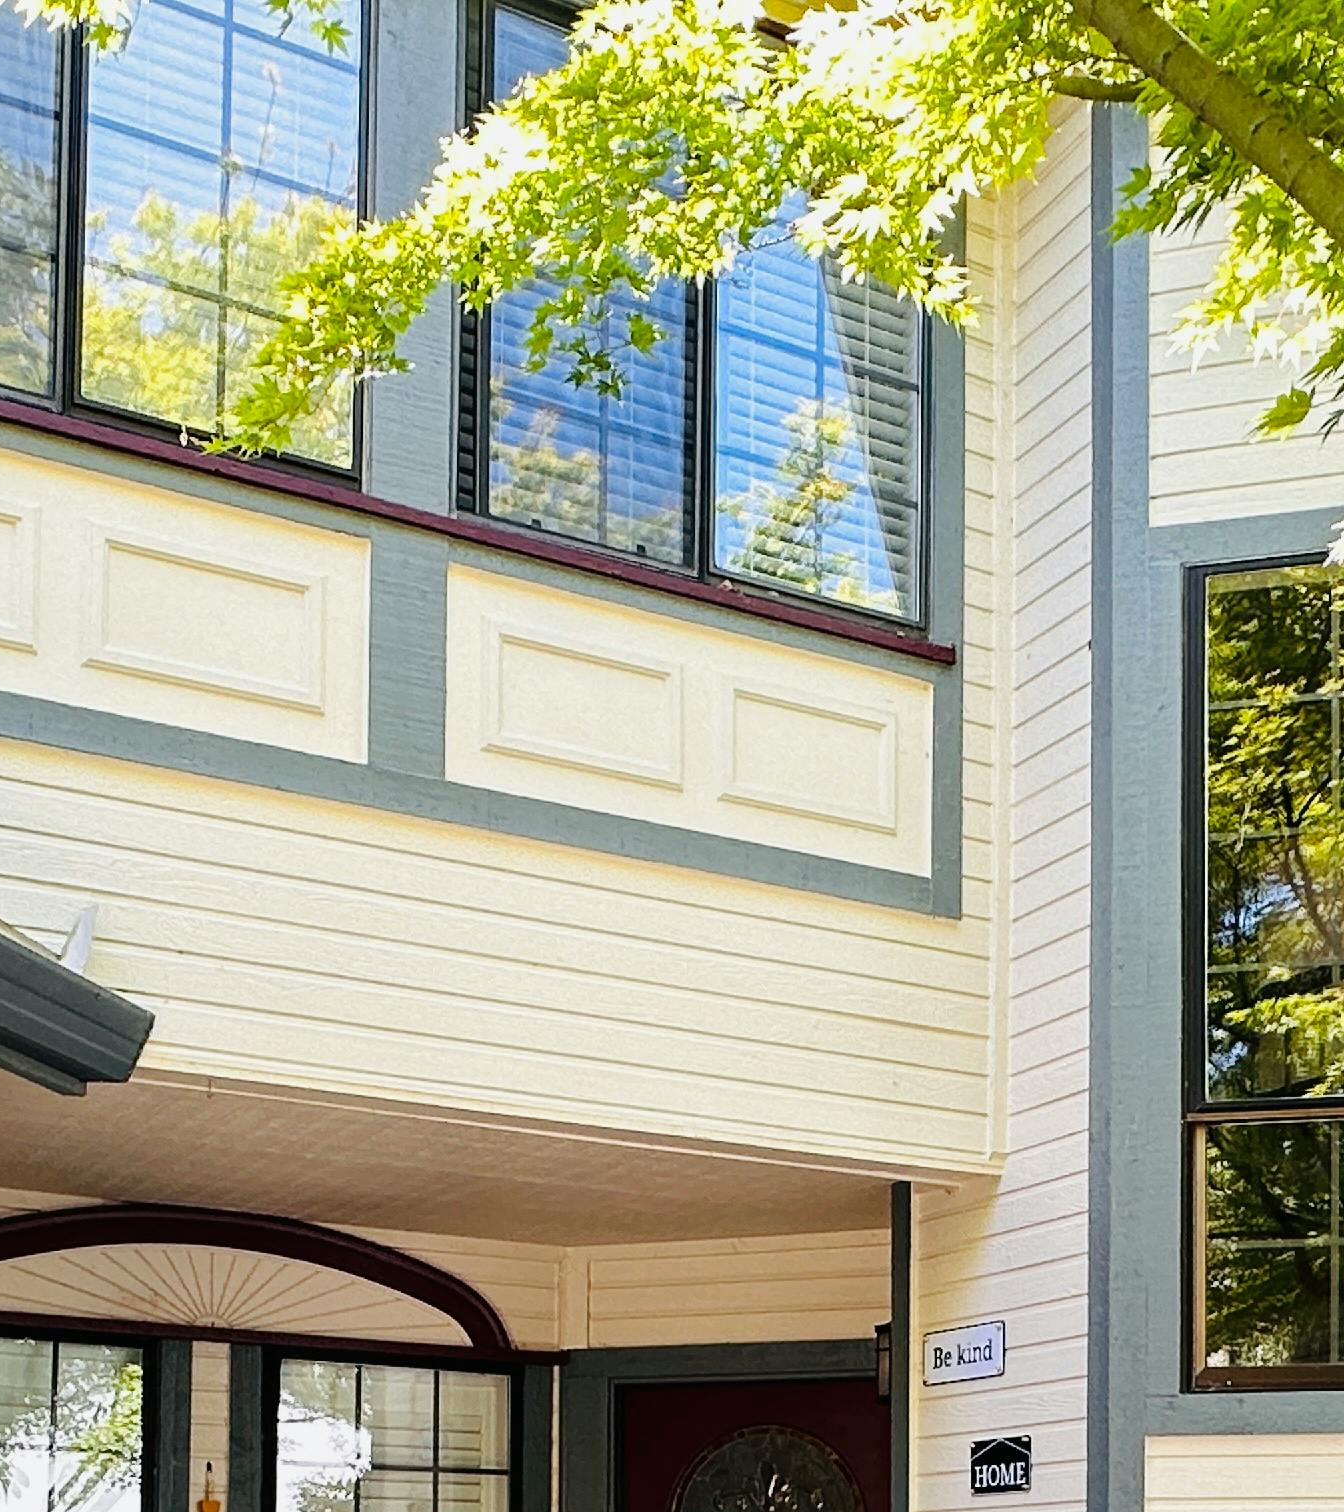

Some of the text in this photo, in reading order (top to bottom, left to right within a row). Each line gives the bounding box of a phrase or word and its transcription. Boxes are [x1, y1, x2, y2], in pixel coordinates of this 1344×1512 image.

[933, 1338, 993, 1369] Be kind
[974, 1462, 1026, 1488] HOME
